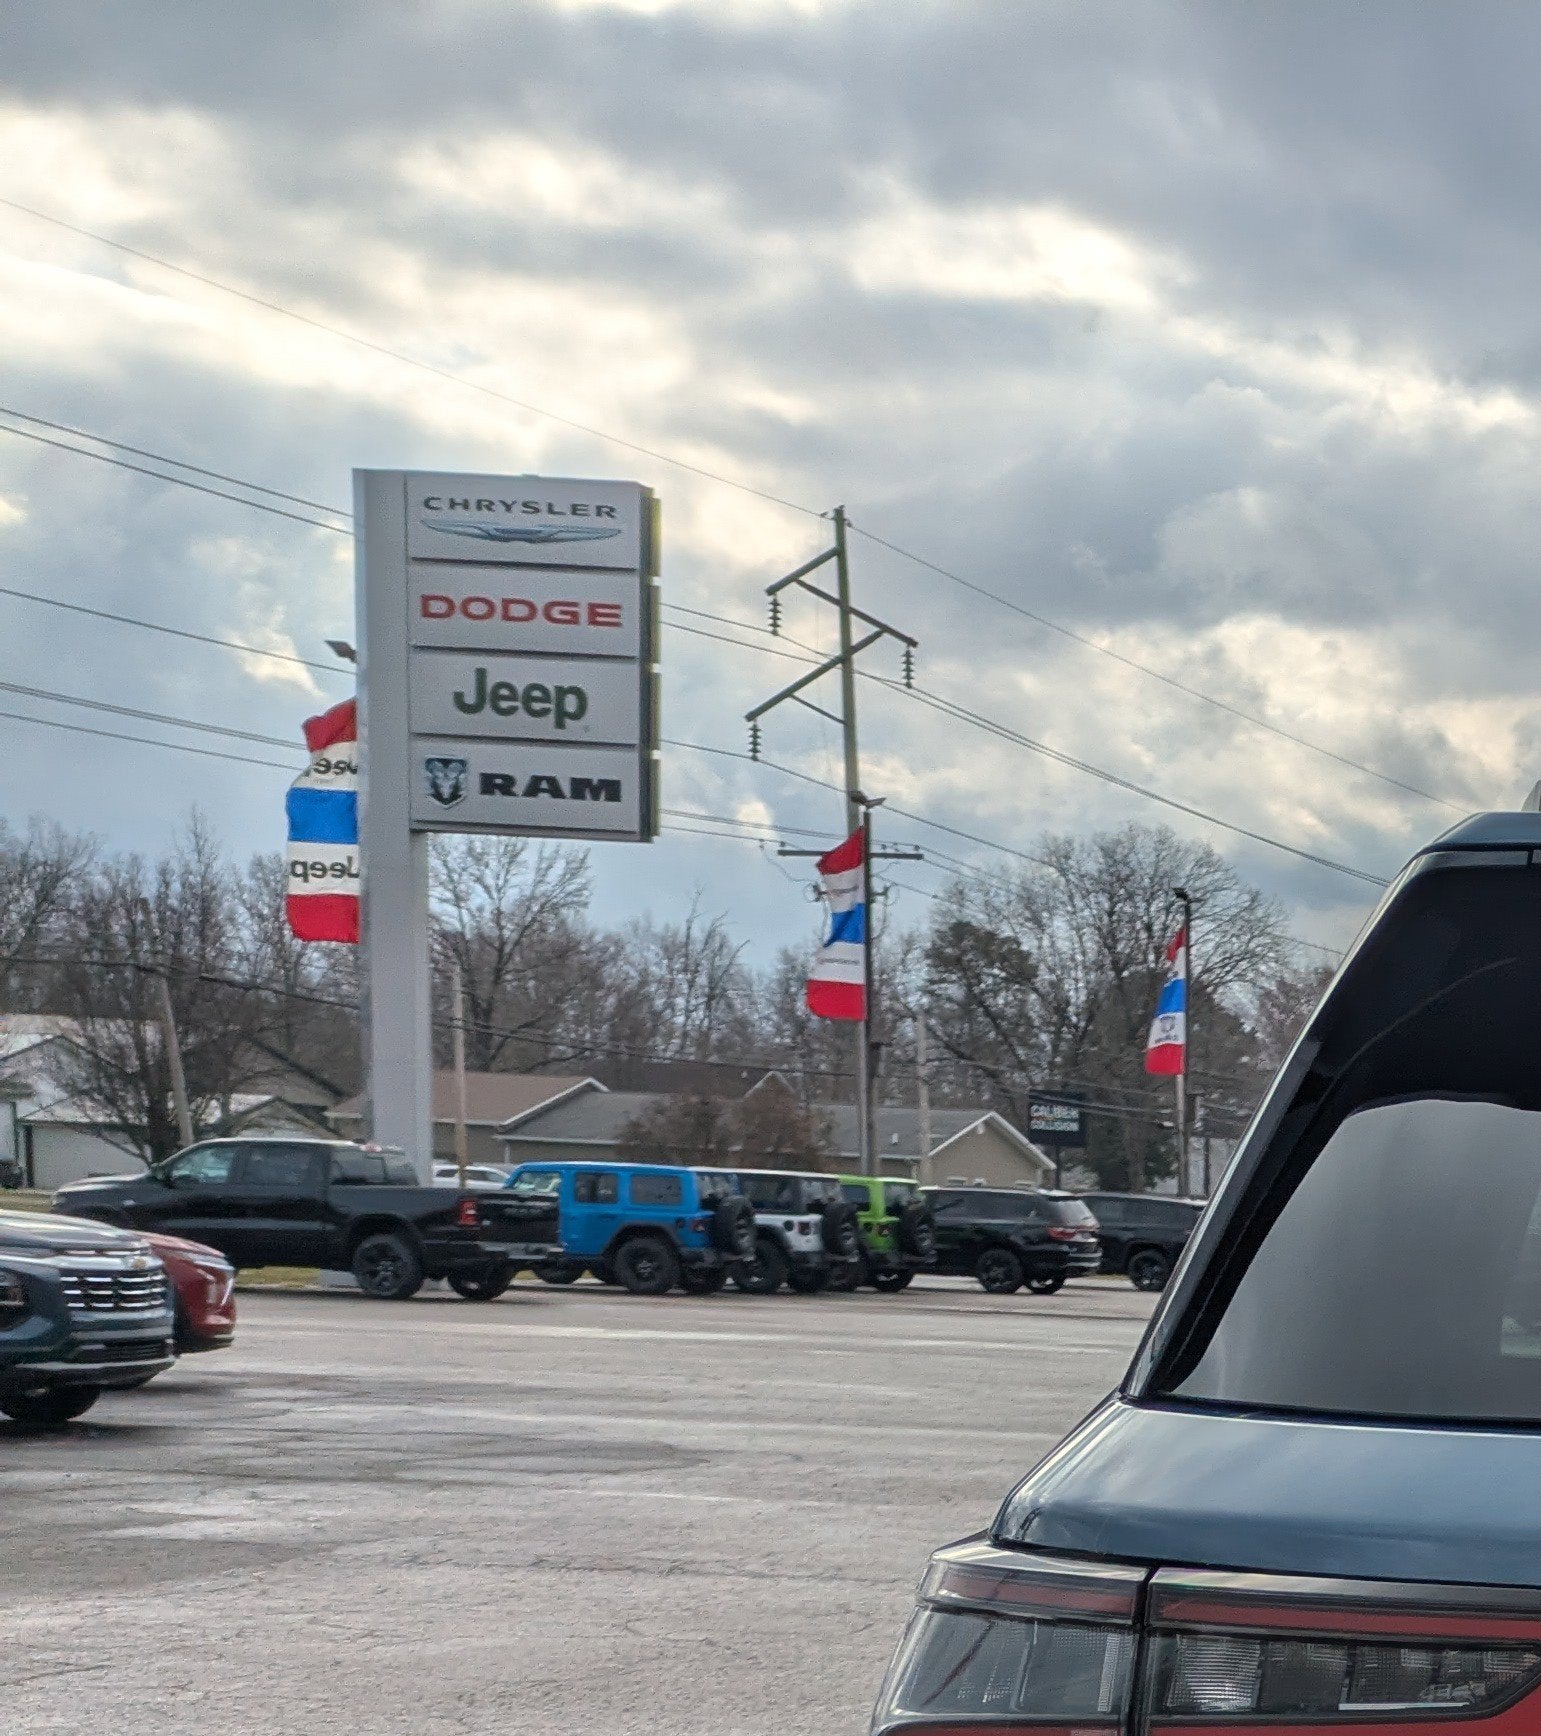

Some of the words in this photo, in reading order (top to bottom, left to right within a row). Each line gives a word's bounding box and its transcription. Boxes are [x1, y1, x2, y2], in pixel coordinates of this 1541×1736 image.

[422, 496, 618, 519] CHRYSLER
[420, 594, 623, 628] DODGE
[453, 667, 589, 731] Jeep
[479, 772, 622, 803] RAM
